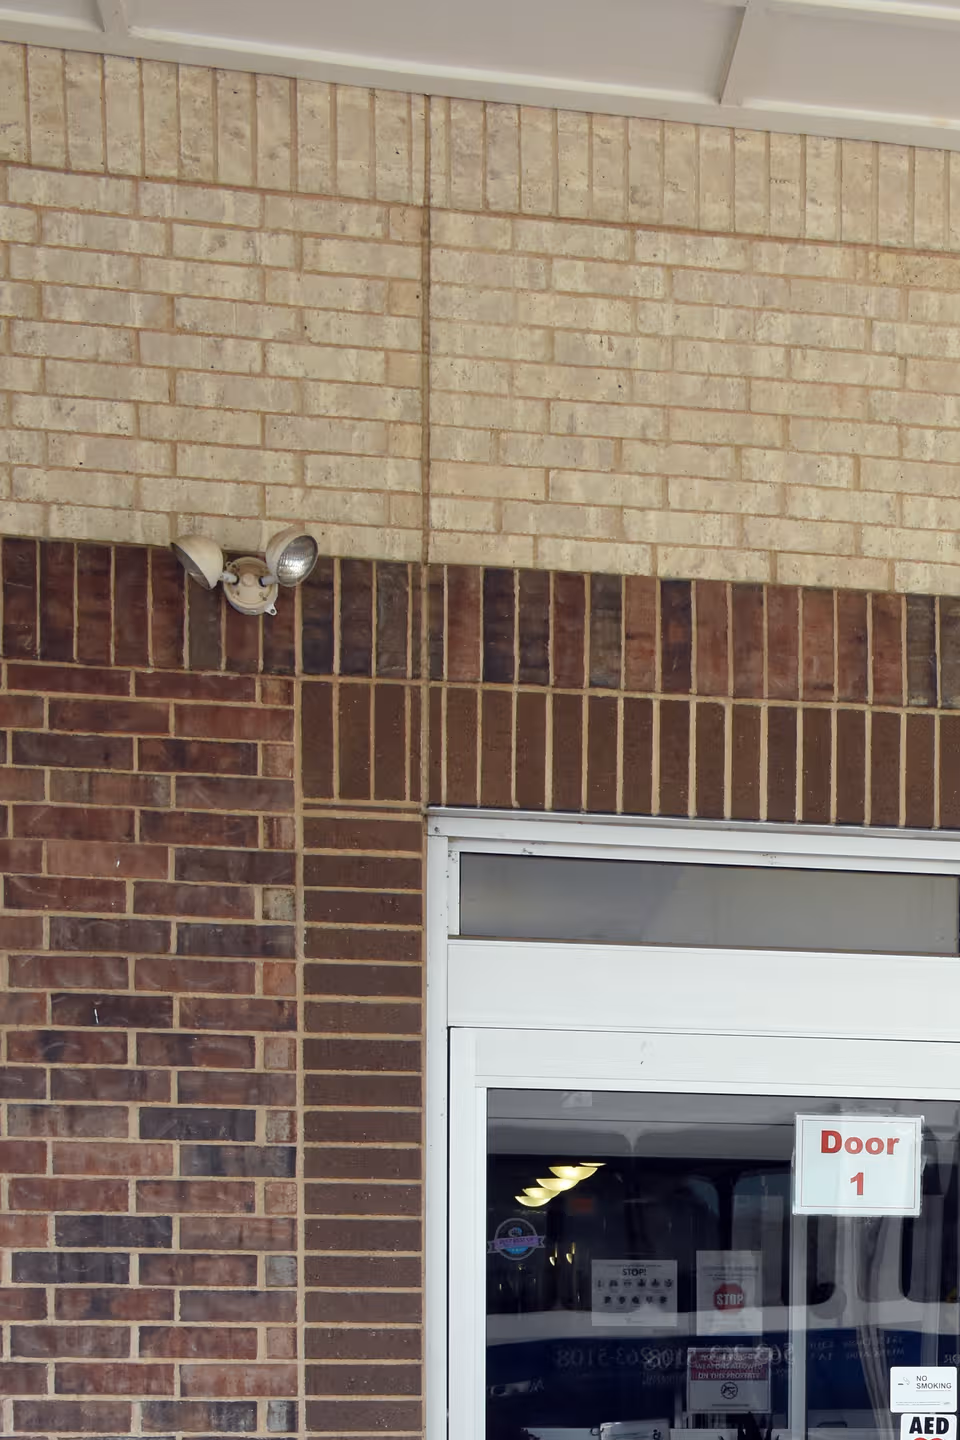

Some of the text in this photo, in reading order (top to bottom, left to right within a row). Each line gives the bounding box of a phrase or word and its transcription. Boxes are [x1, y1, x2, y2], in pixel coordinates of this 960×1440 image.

[820, 1129, 900, 1155] Door
[850, 1172, 864, 1196] 1
[622, 1268, 647, 1276] STOP!
[716, 1294, 744, 1305] STOP
[916, 1382, 952, 1390] SMOKING
[909, 1416, 950, 1435] AED
